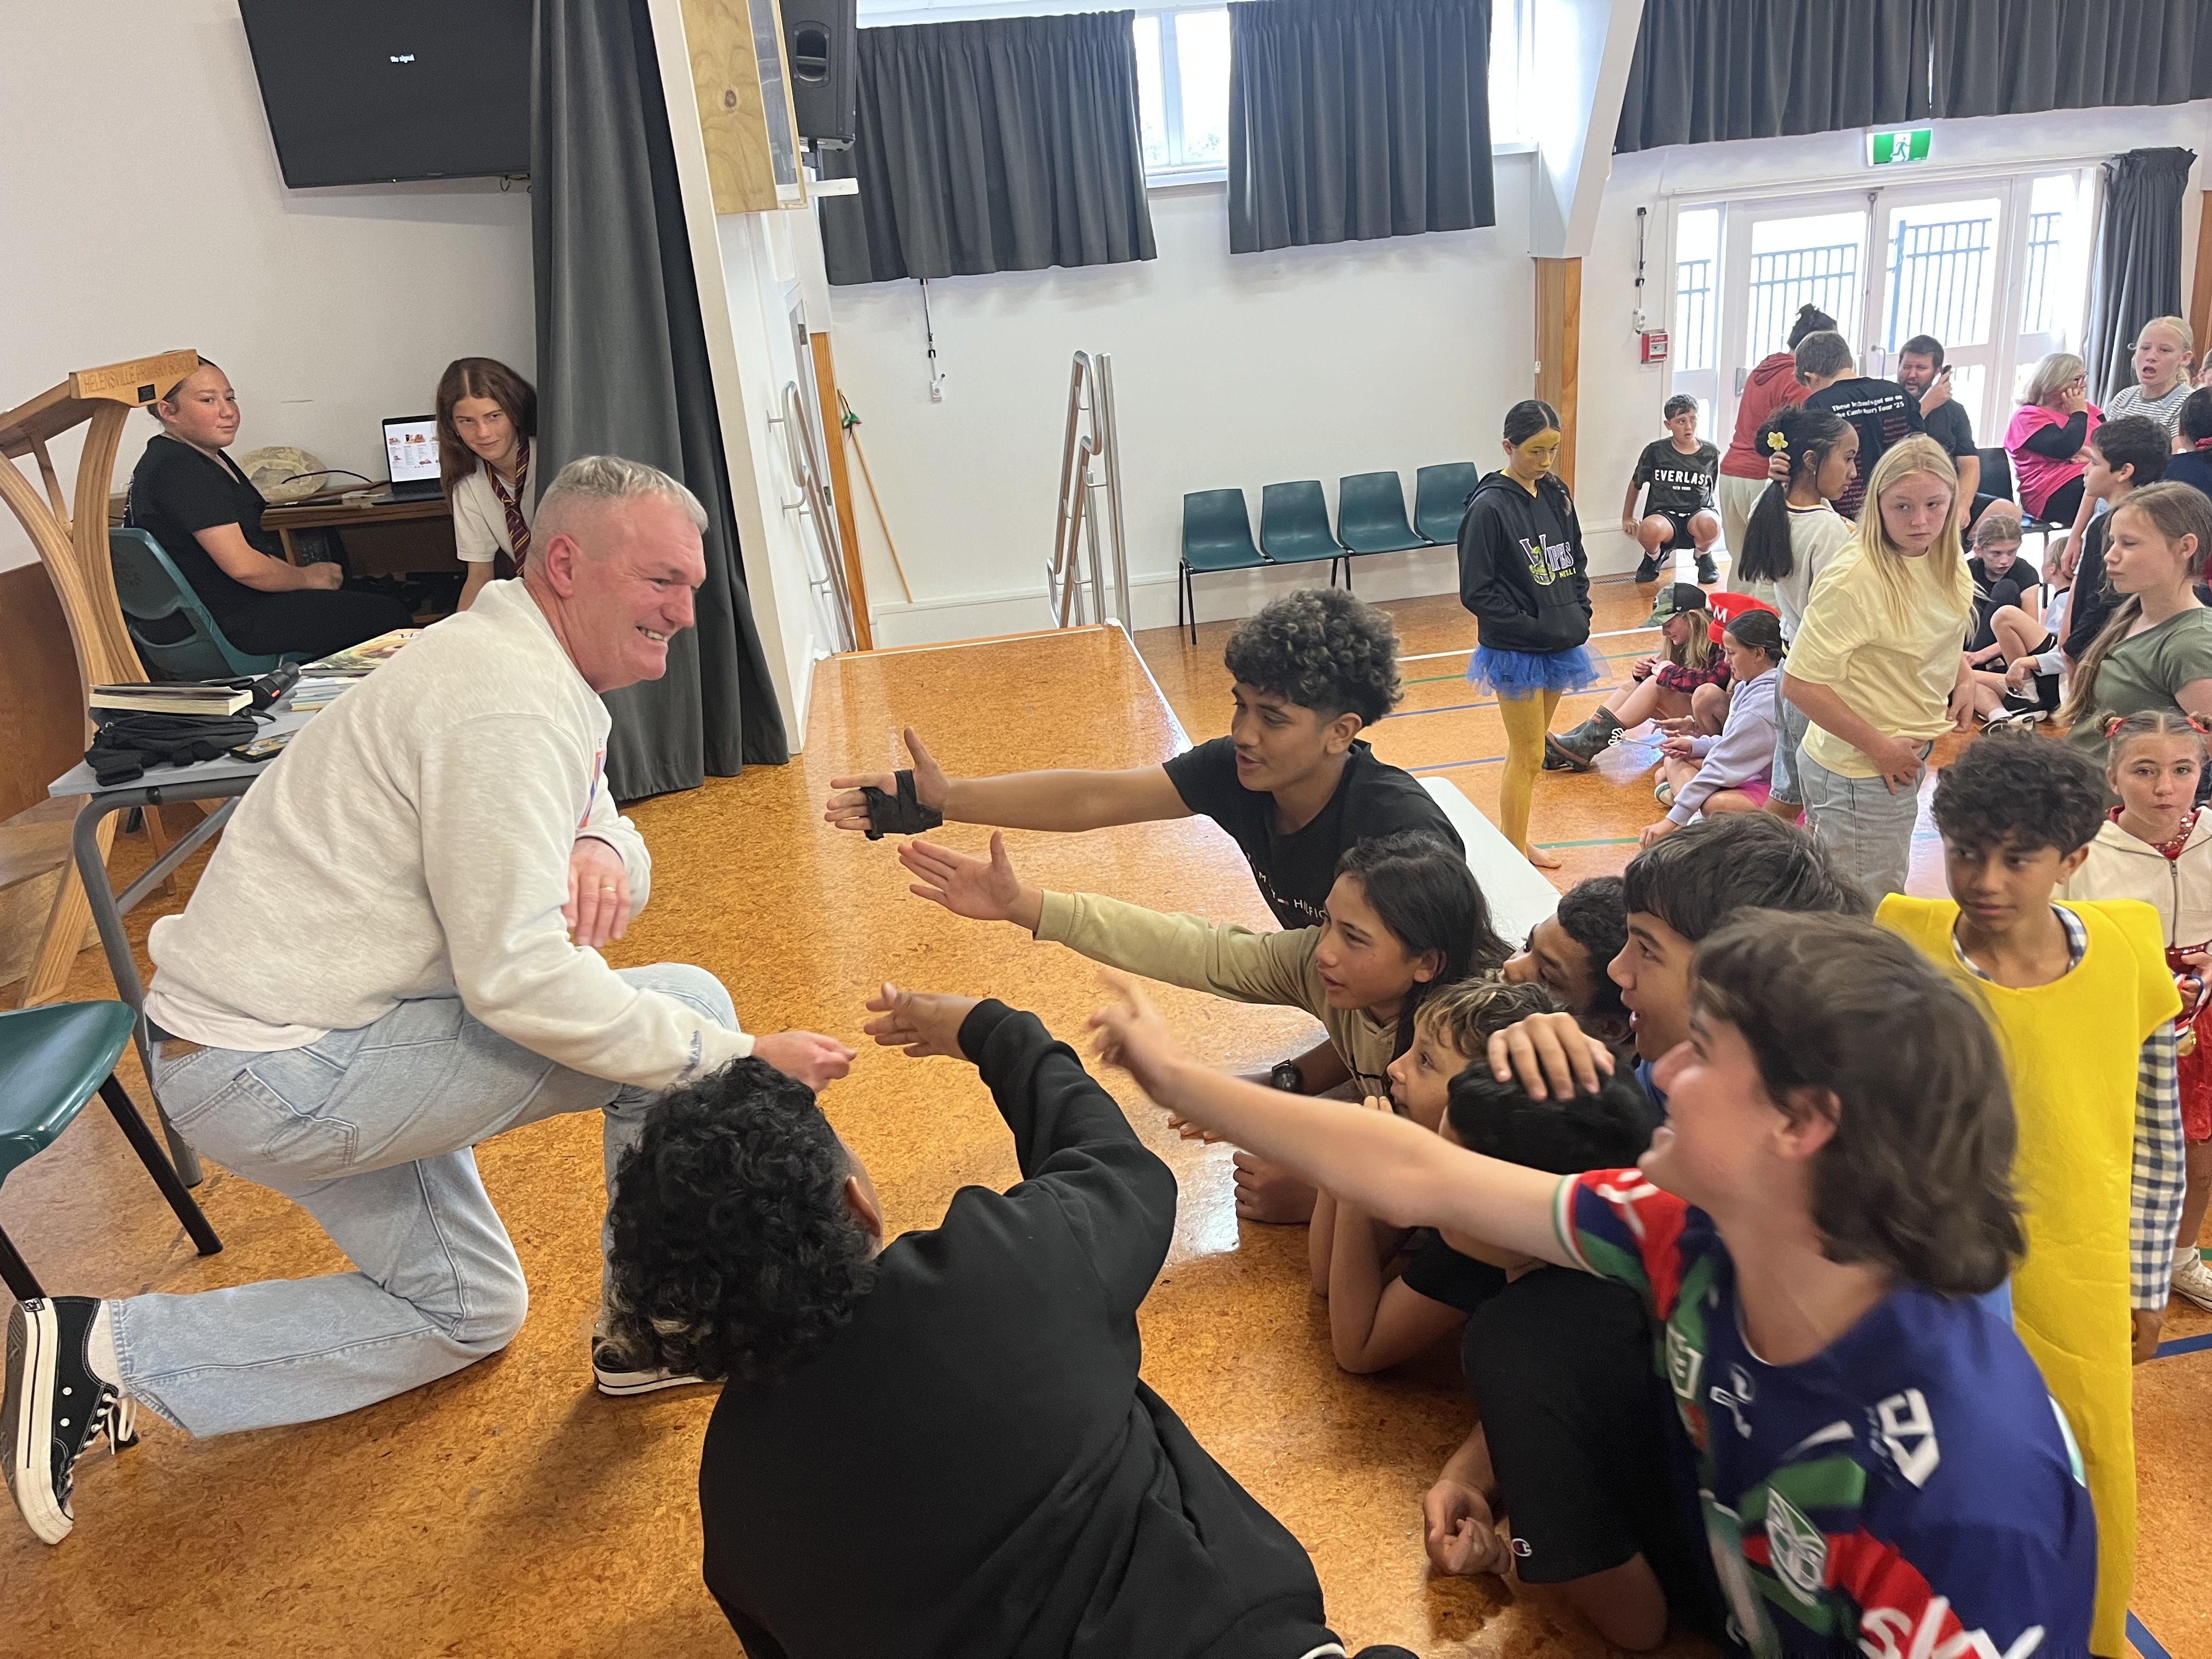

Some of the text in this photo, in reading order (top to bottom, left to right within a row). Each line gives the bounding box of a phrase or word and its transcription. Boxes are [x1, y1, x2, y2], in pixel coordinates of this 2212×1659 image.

[1832, 403, 1850, 411] These
[1846, 407, 1877, 416] Cantebury
[1713, 605, 1729, 623] M
